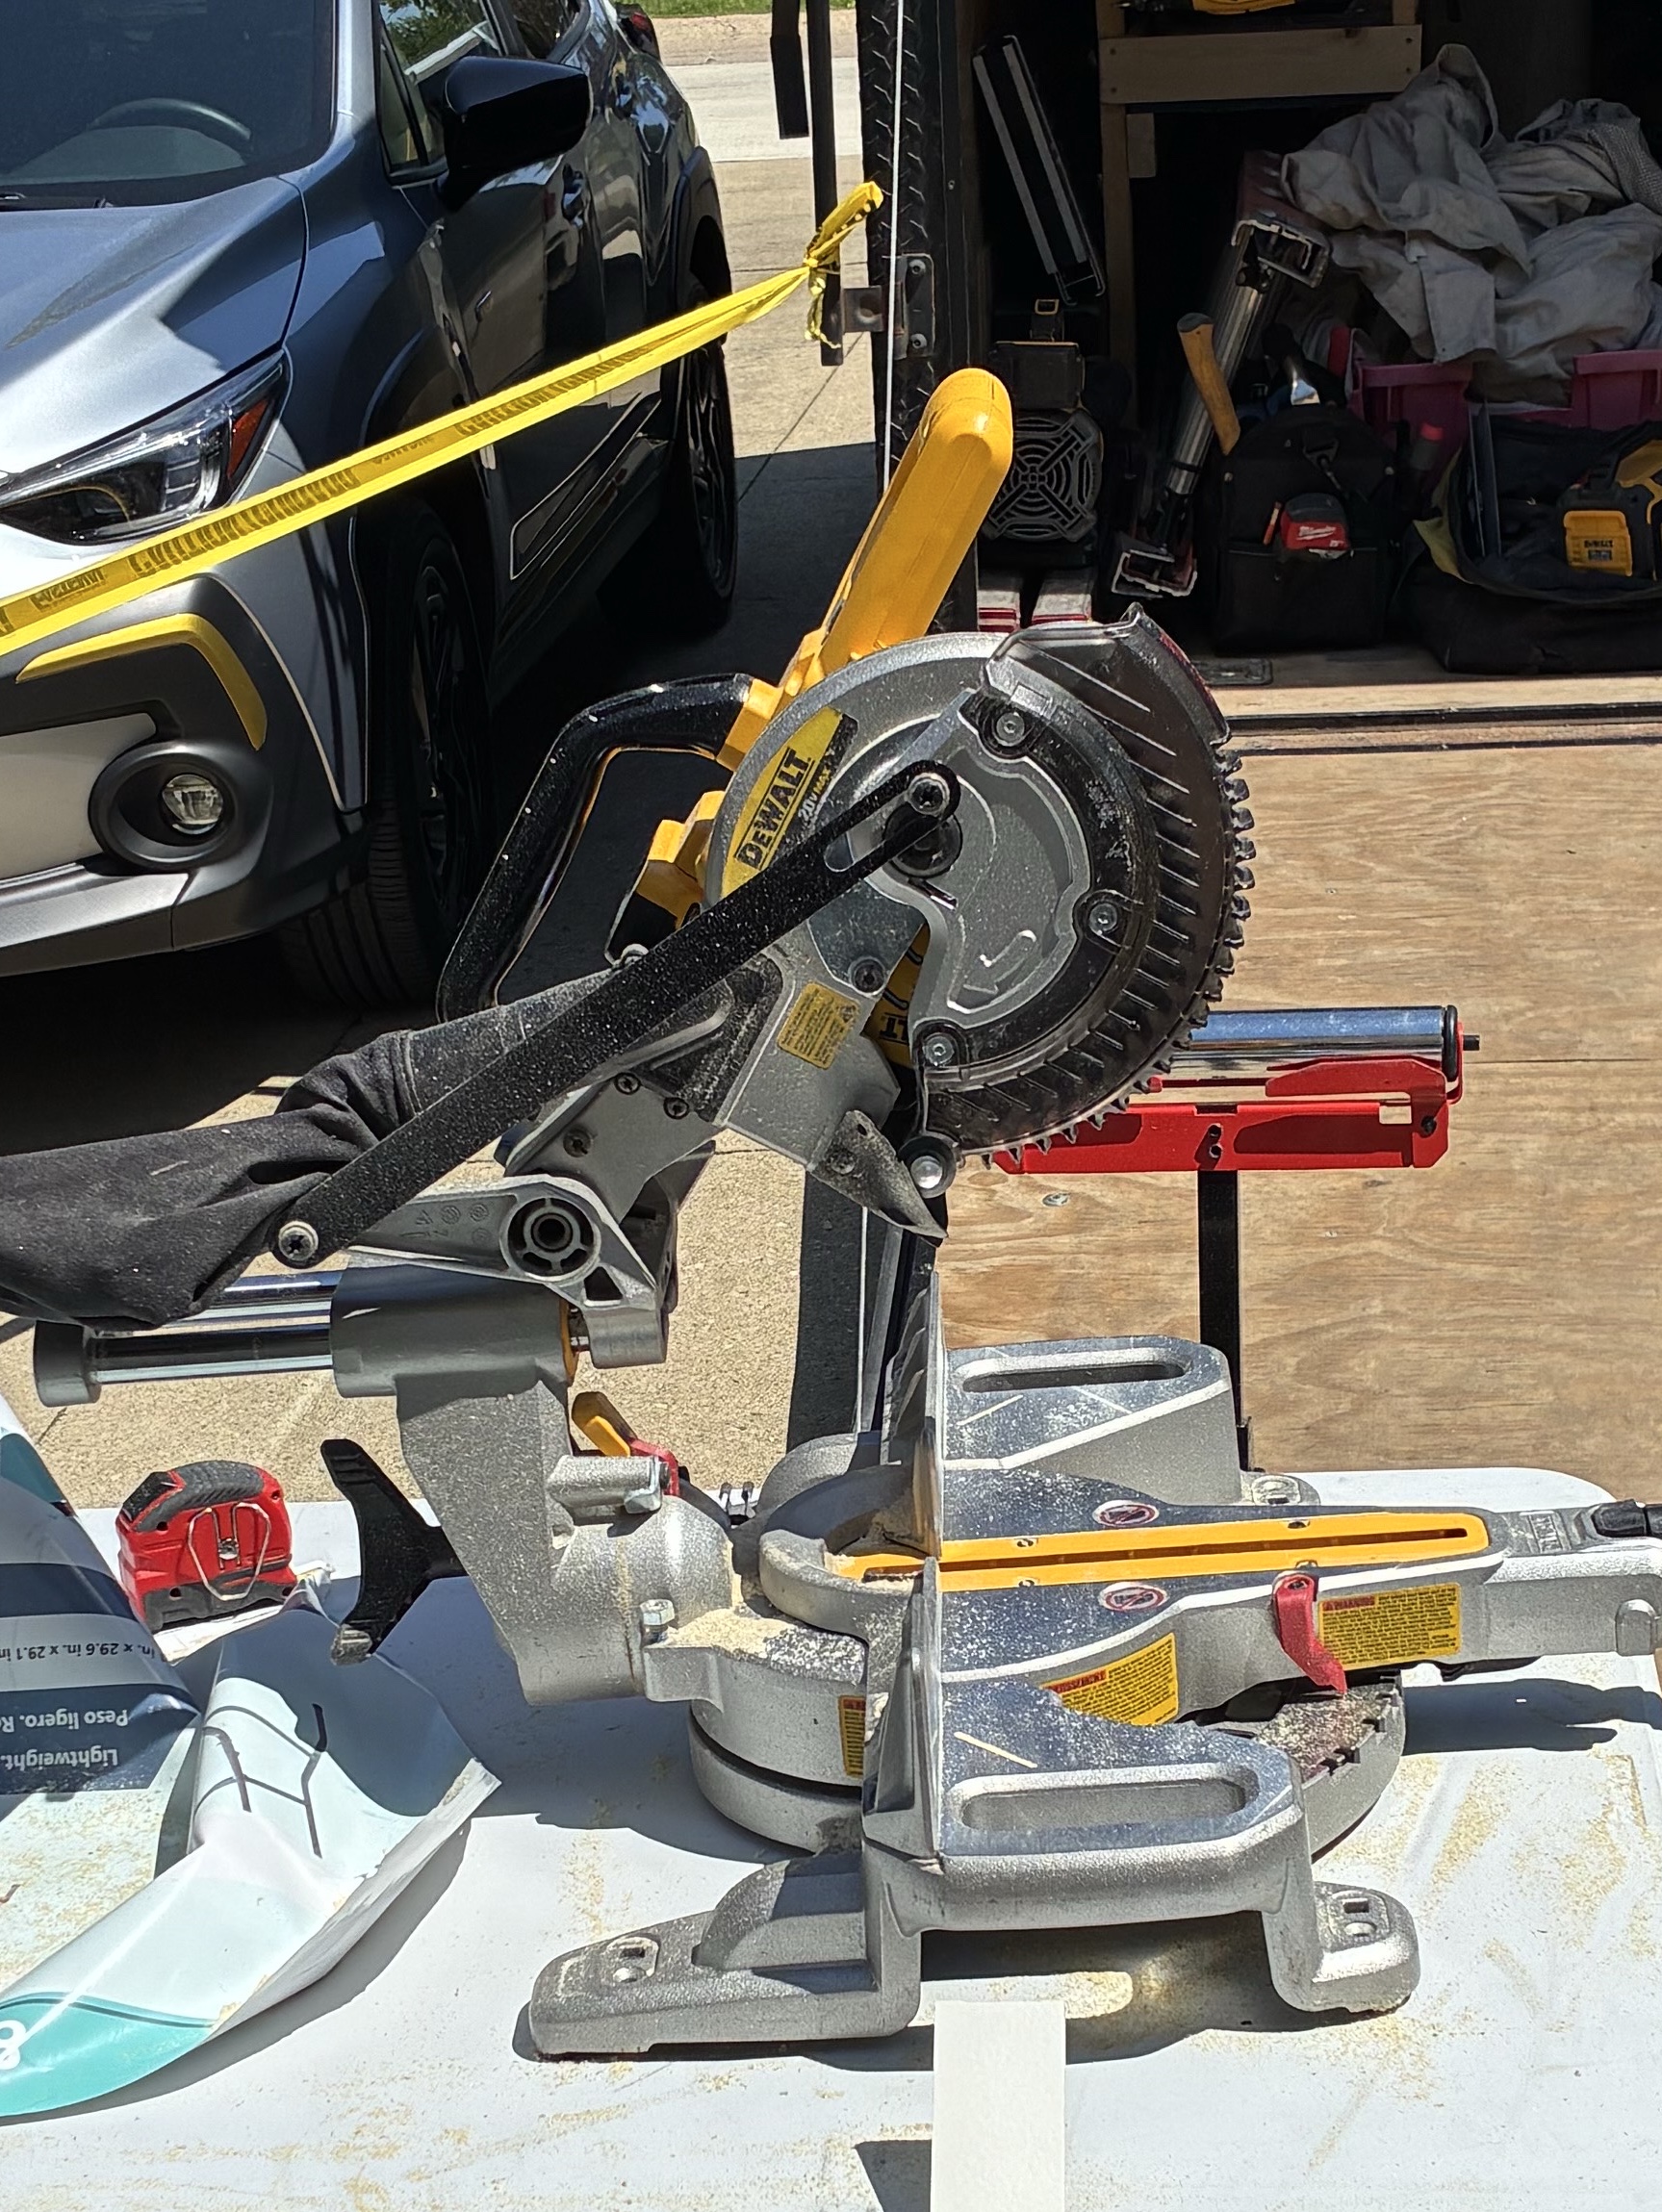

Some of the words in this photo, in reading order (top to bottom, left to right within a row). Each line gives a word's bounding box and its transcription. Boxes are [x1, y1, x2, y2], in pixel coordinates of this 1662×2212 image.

[16, 1646, 45, 1661] 29.1
[49, 1644, 59, 1655] x
[63, 1643, 82, 1657] in.
[86, 1642, 119, 1656] 29.6
[123, 1643, 133, 1653] x
[19, 1708, 79, 1730] ligero.
[84, 1710, 129, 1727] Peso
[0, 1745, 117, 1771] Lightweight.
